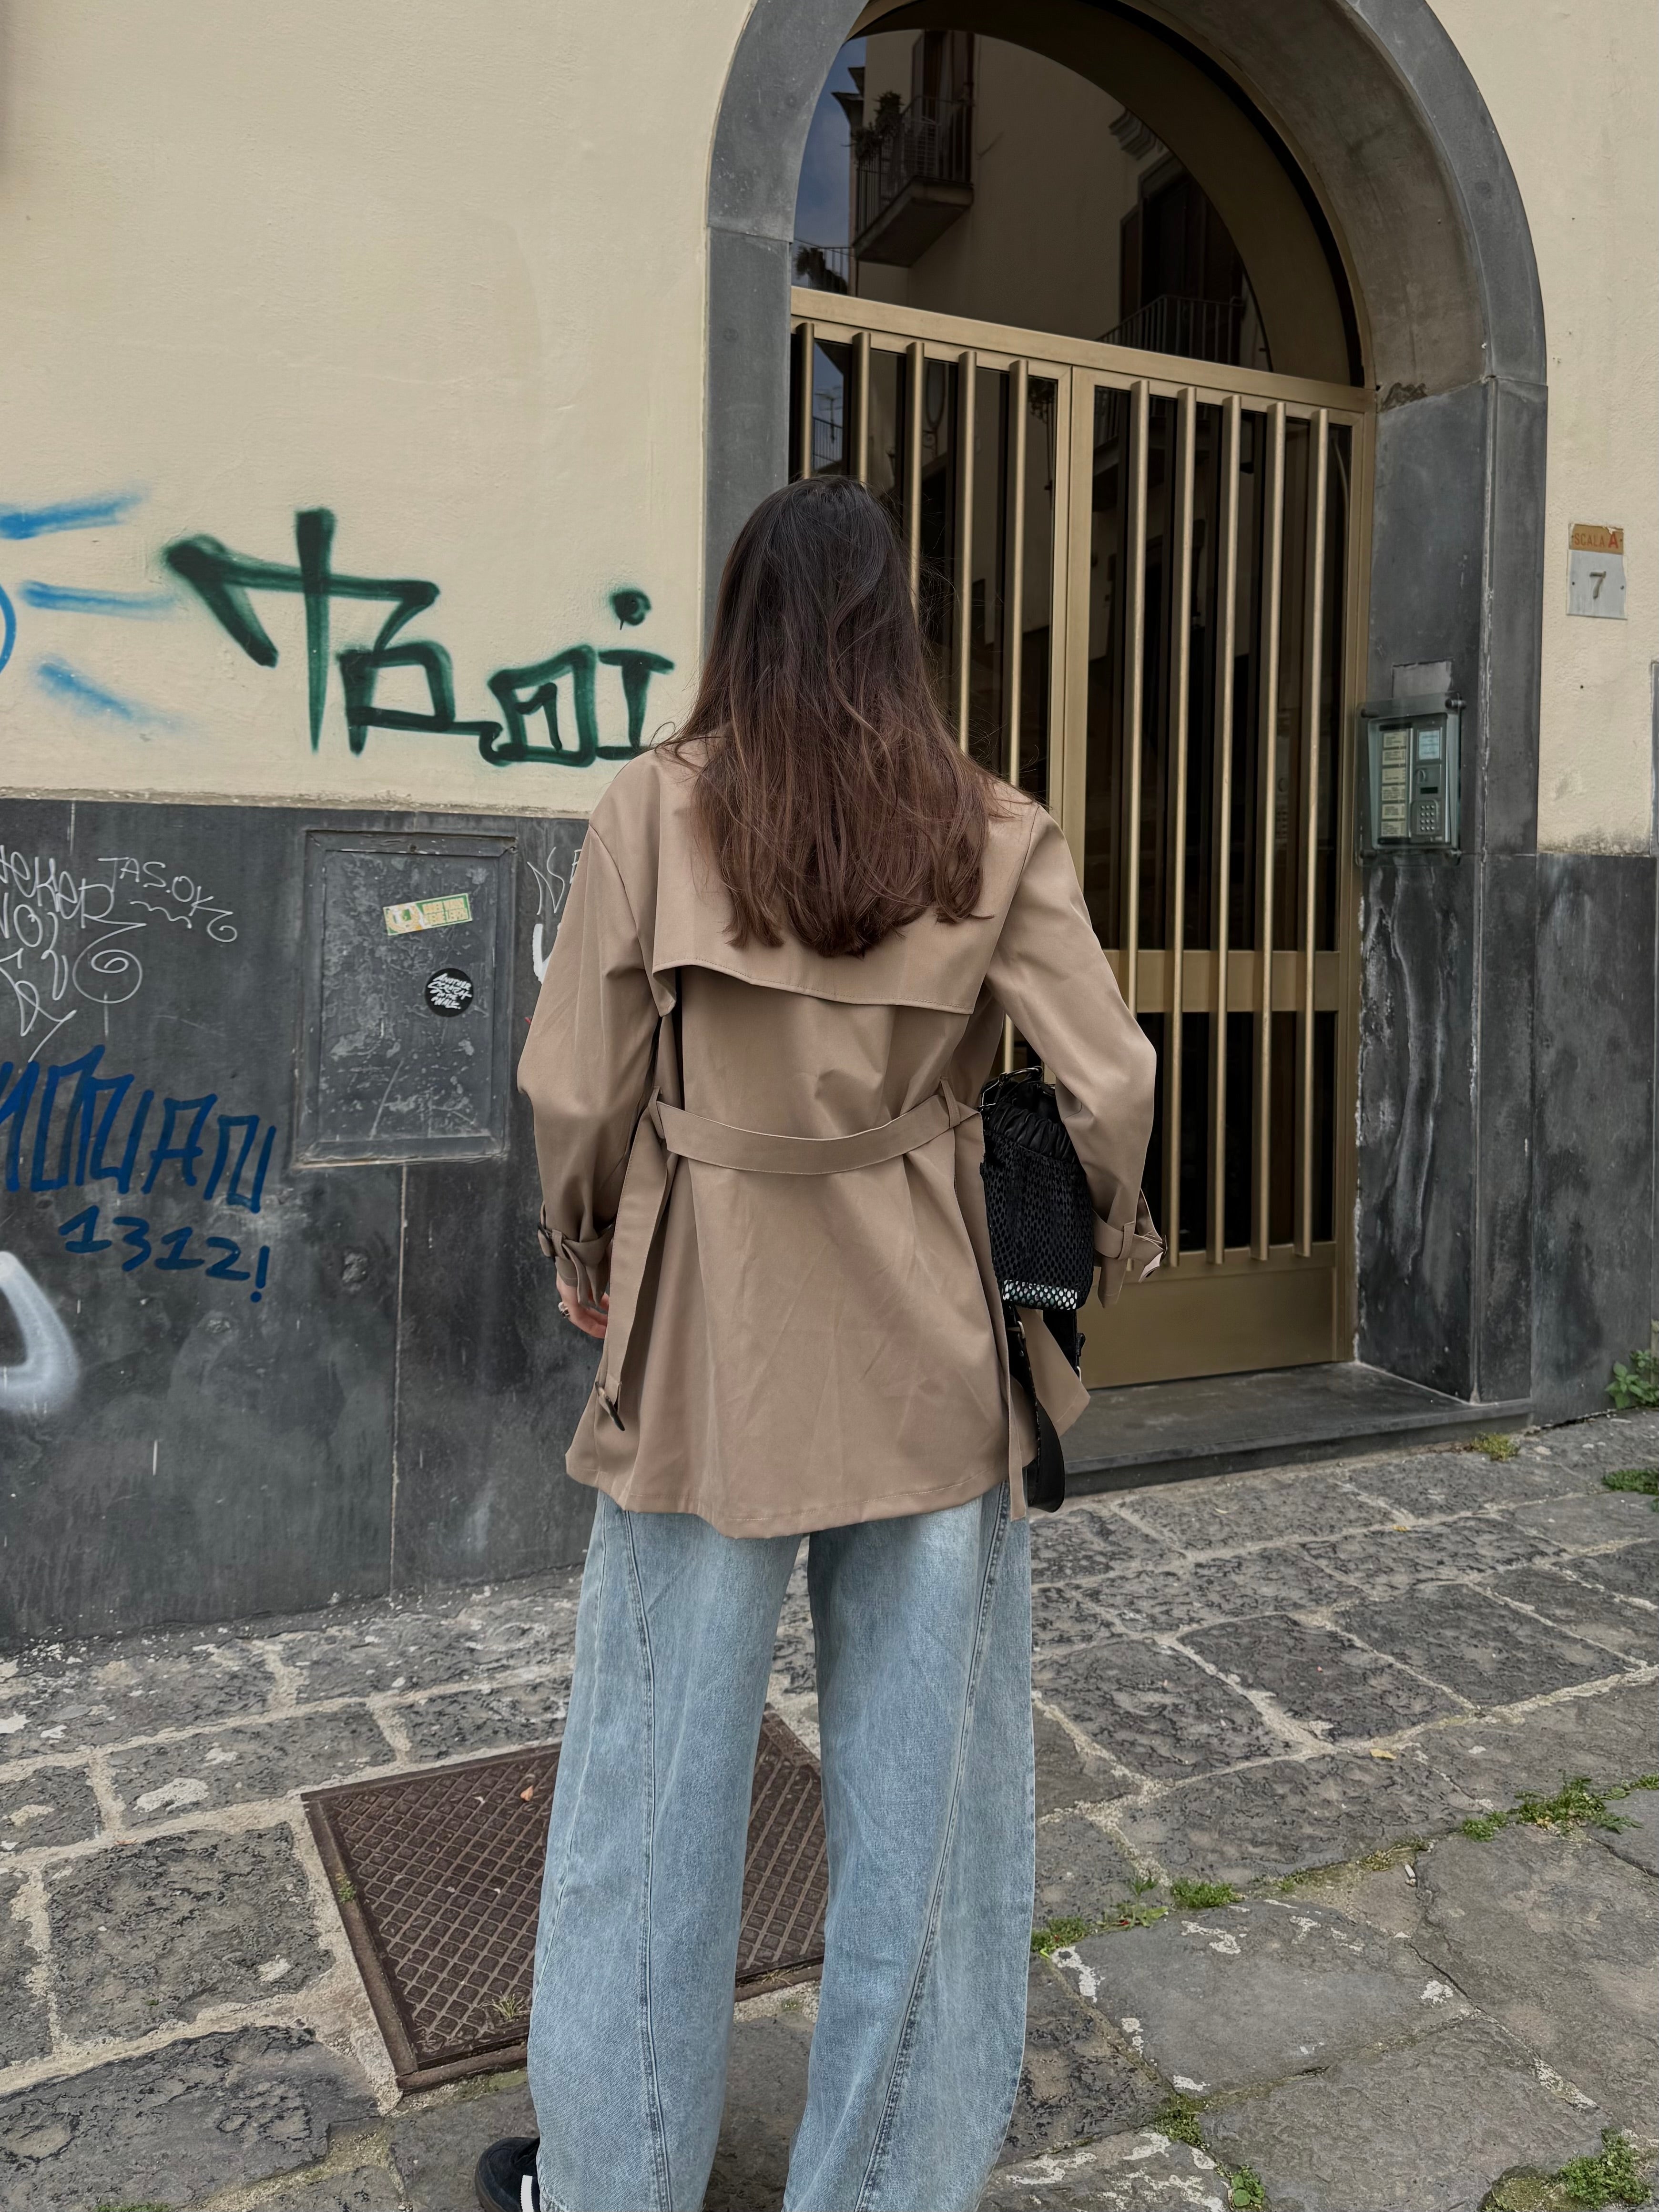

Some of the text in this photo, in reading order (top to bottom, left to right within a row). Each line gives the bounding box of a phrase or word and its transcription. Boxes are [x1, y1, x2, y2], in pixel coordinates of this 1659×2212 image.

[1574, 532, 1618, 549] SCALA A
[1589, 571, 1607, 599] 7
[427, 981, 472, 1000] SCRATCH
[59, 1205, 271, 1304] 1312!
